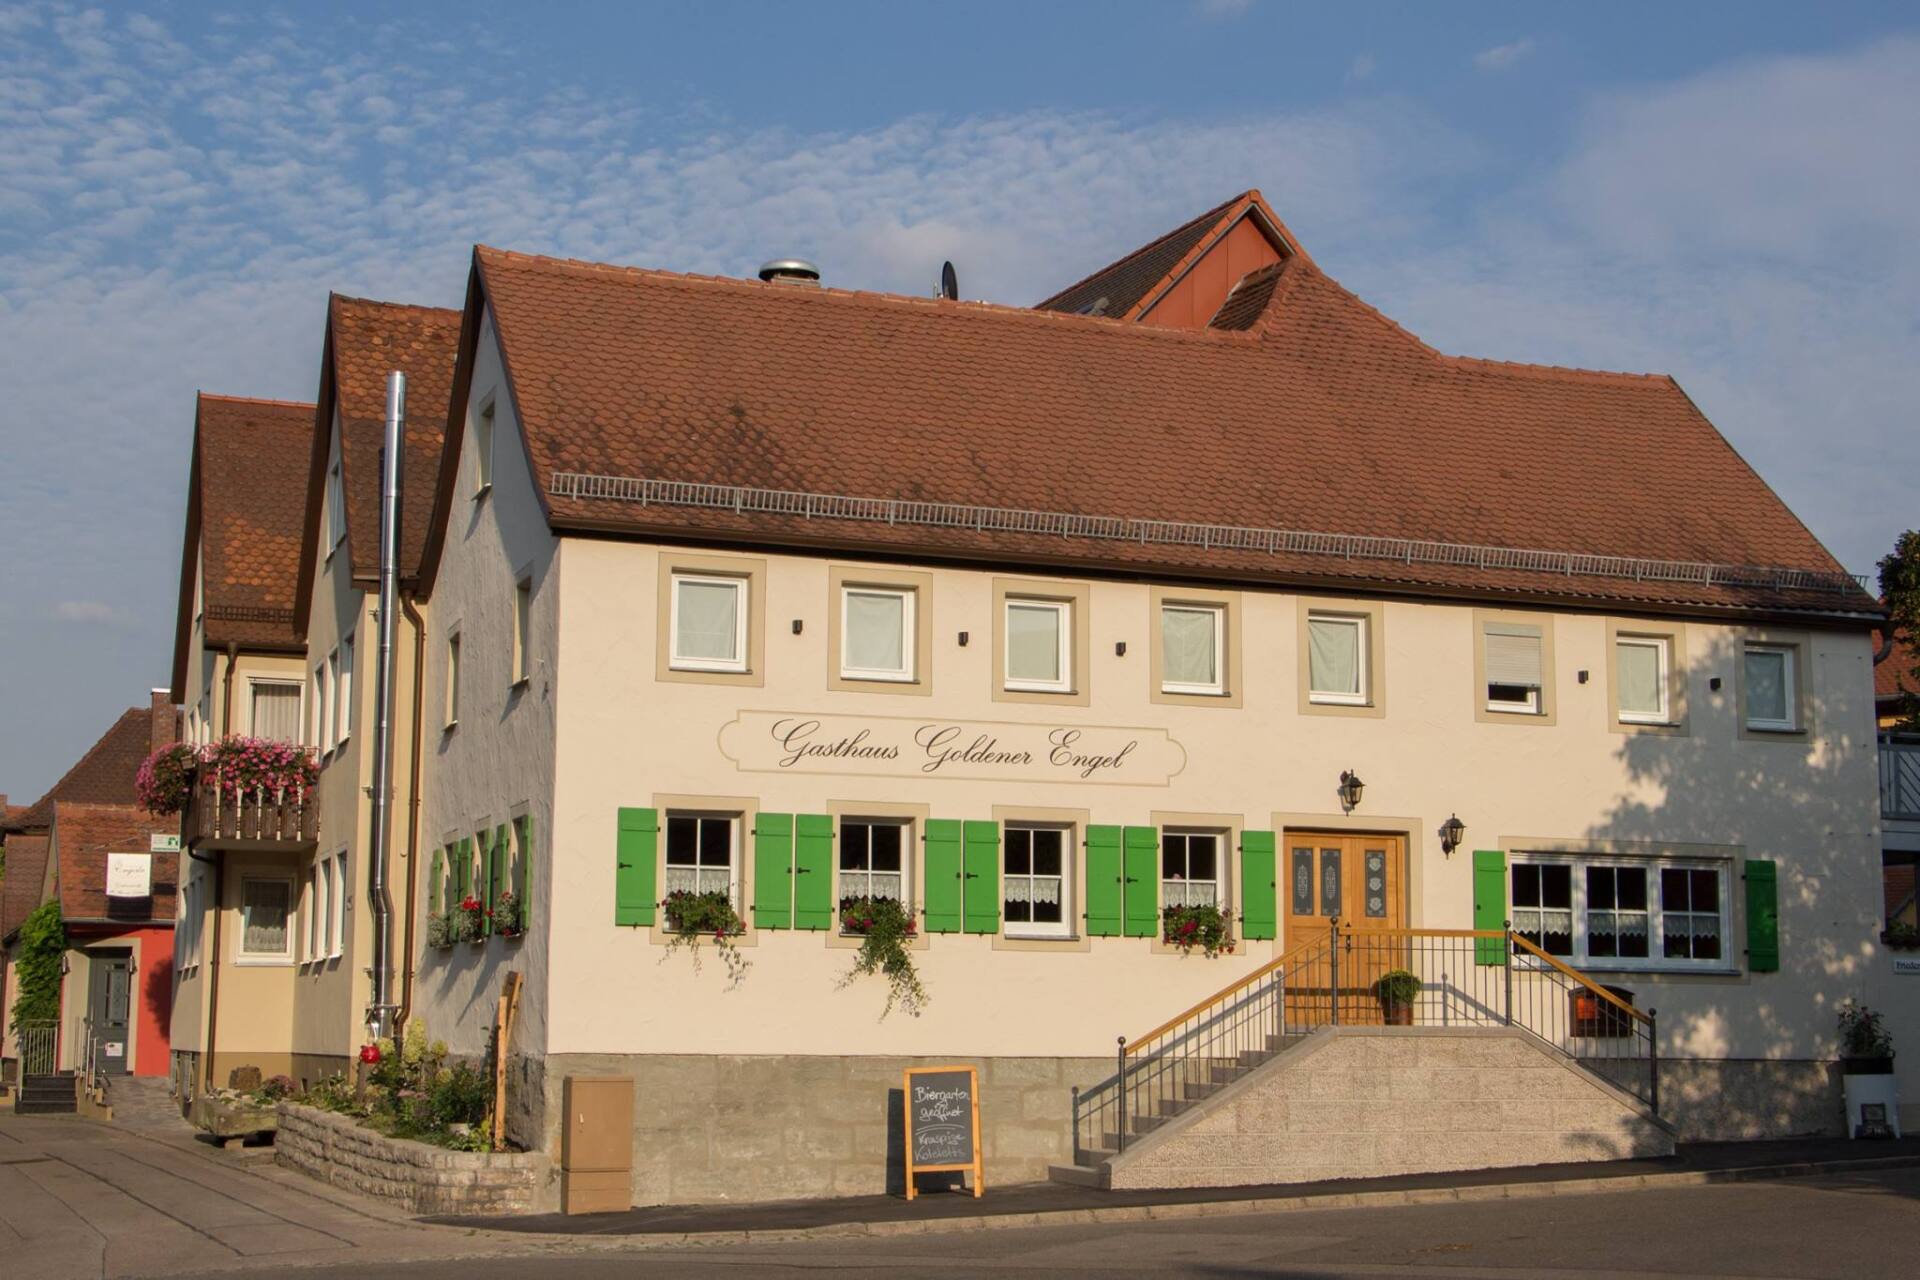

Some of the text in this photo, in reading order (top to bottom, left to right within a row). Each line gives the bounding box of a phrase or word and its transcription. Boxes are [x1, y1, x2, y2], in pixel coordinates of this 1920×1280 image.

[771, 718, 1138, 779] Gasthaus Goldener Engel
